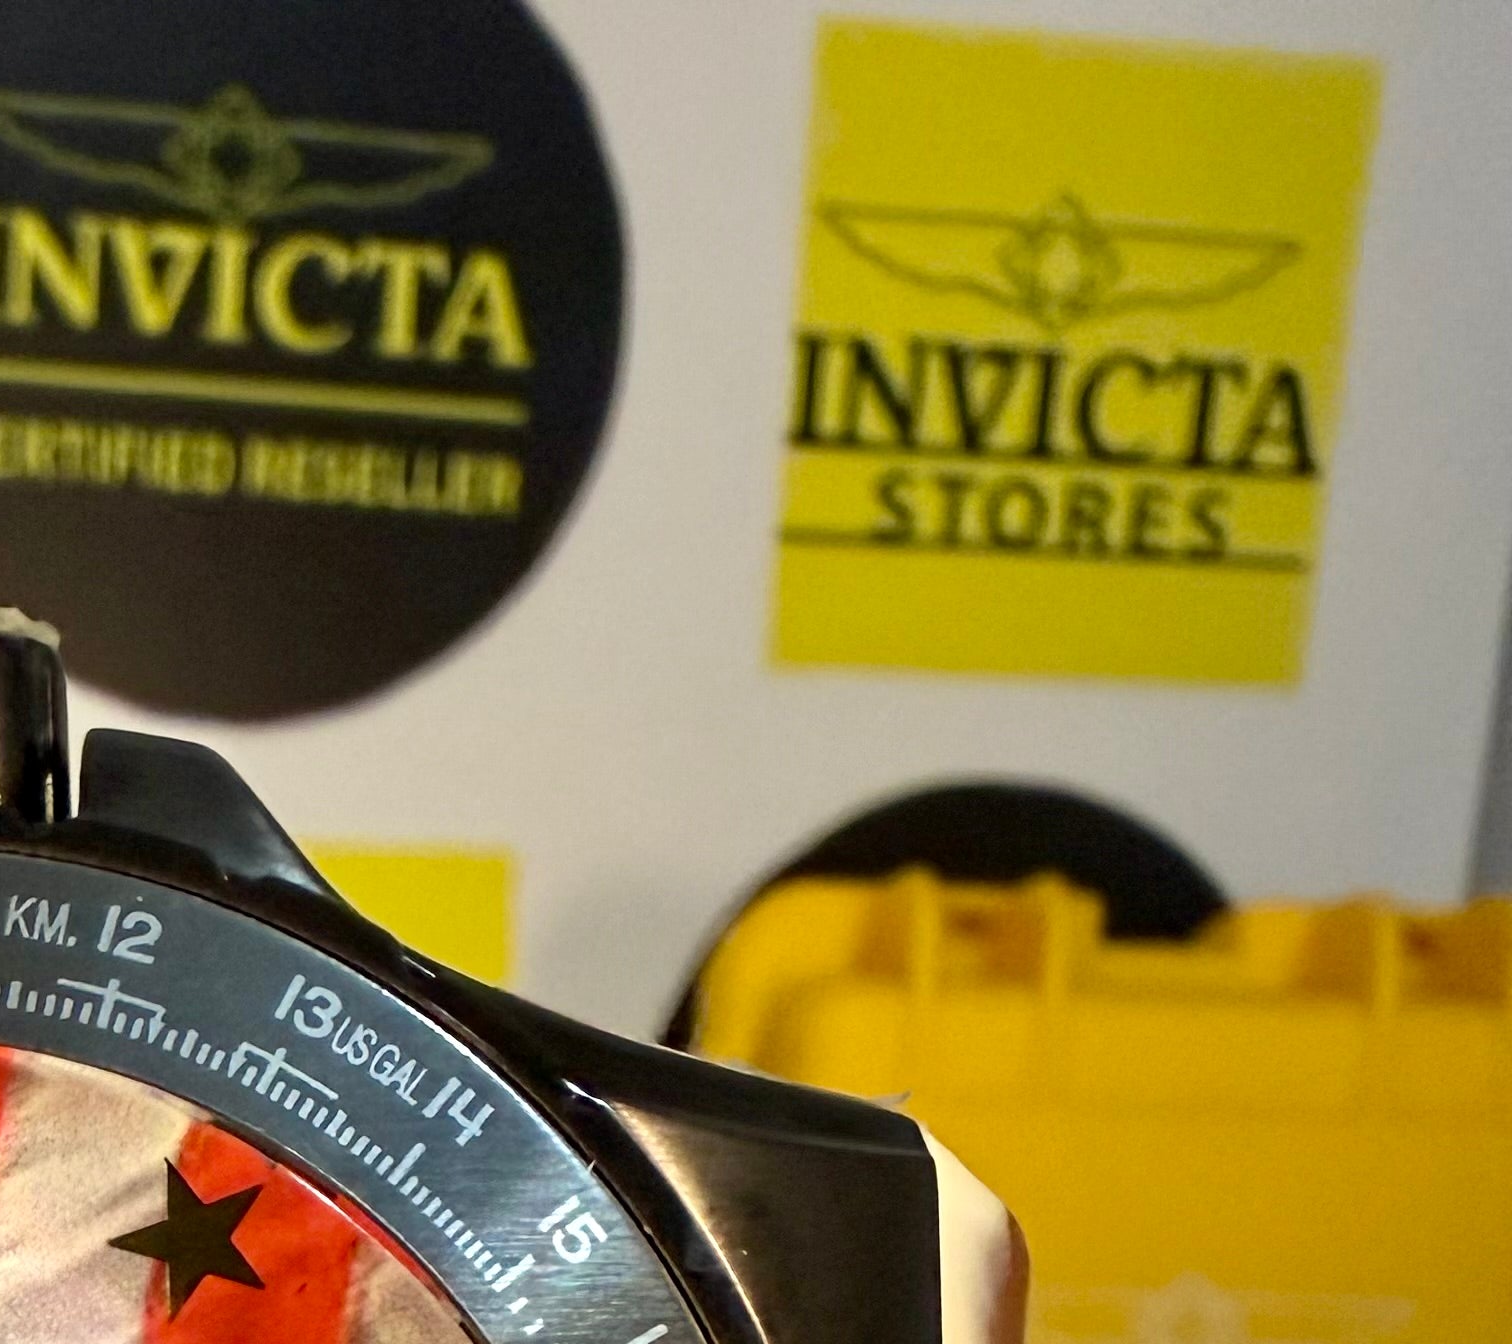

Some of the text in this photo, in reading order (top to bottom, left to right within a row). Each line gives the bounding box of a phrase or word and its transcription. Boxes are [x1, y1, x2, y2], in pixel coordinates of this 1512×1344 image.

[788, 327, 1317, 478] INVICTA
[242, 430, 524, 520] RESELLER
[870, 470, 1232, 563] STORES
[3, 895, 77, 947] KM.
[97, 905, 163, 964] 12
[274, 974, 343, 1038] 13
[421, 1076, 495, 1147] 14
[537, 1195, 608, 1264] 15
